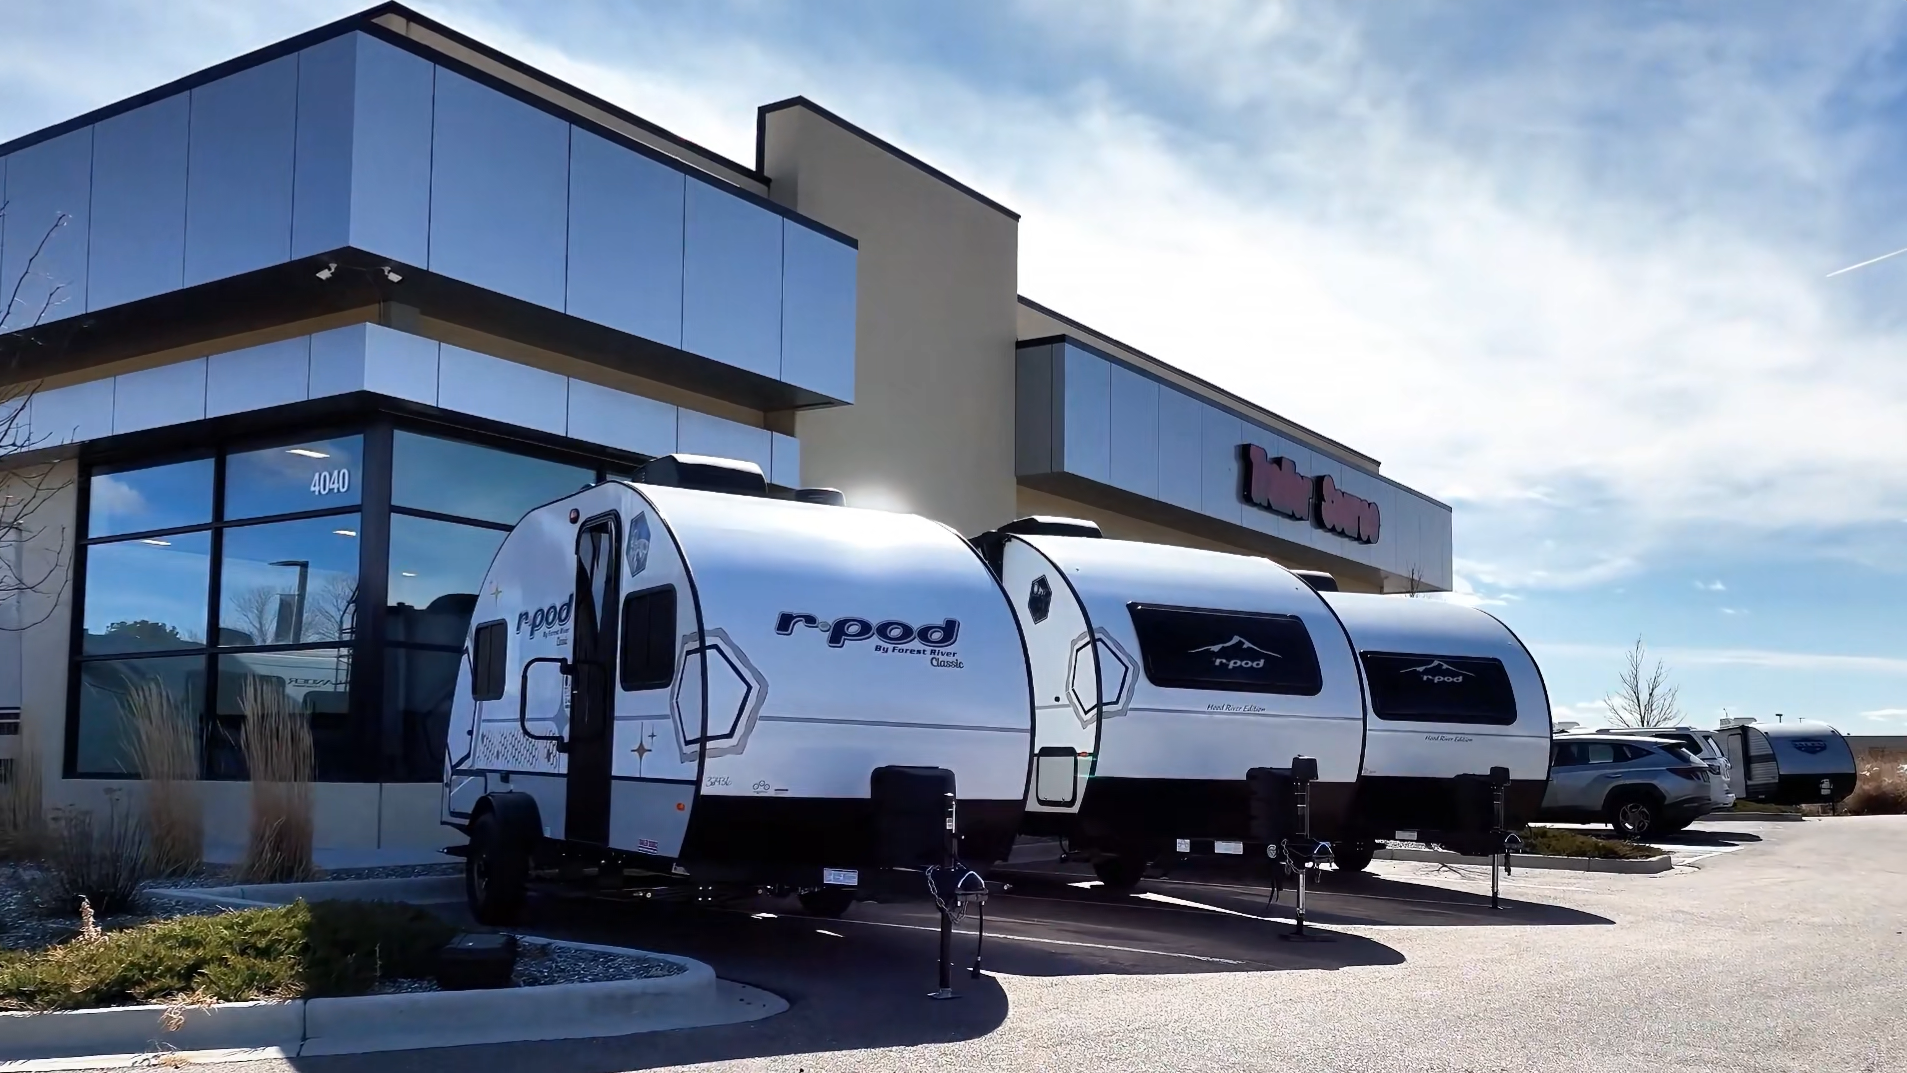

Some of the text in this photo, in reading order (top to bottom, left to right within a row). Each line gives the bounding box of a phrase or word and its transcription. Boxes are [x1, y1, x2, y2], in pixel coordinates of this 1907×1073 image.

[310, 468, 349, 495] 4040
[875, 644, 958, 658] By Forest River
[930, 656, 965, 669] Classic
[1206, 703, 1266, 713] Hood River Edition
